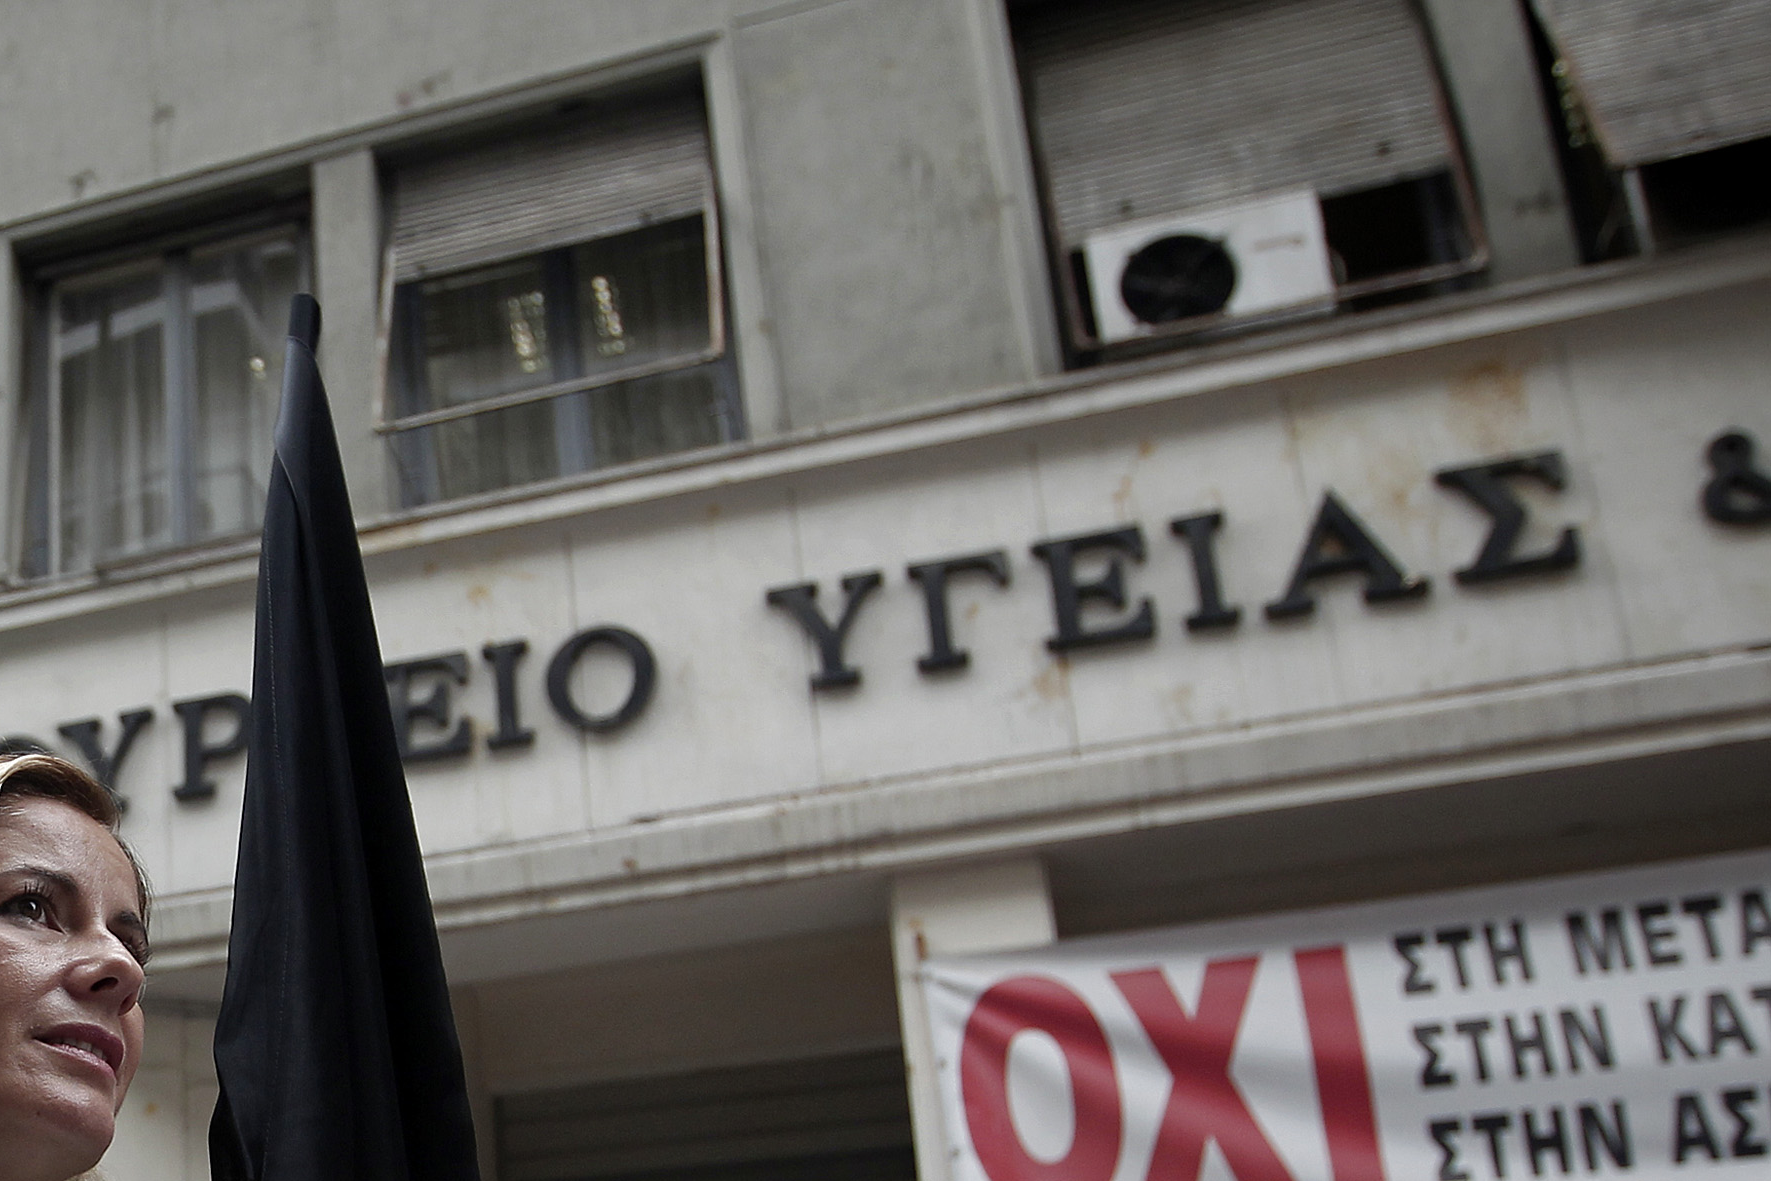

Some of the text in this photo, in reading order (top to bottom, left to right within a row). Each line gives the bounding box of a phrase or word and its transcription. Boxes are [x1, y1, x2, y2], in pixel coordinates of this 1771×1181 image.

[767, 449, 1582, 692] ΥΓΕΙΑΣ
[1393, 887, 1771, 996] ΣΤΗ ΜΕΤΑ
[1411, 1004, 1617, 1088] ΣΤΗΝ
[1671, 1085, 1771, 1166] ΑΣ
